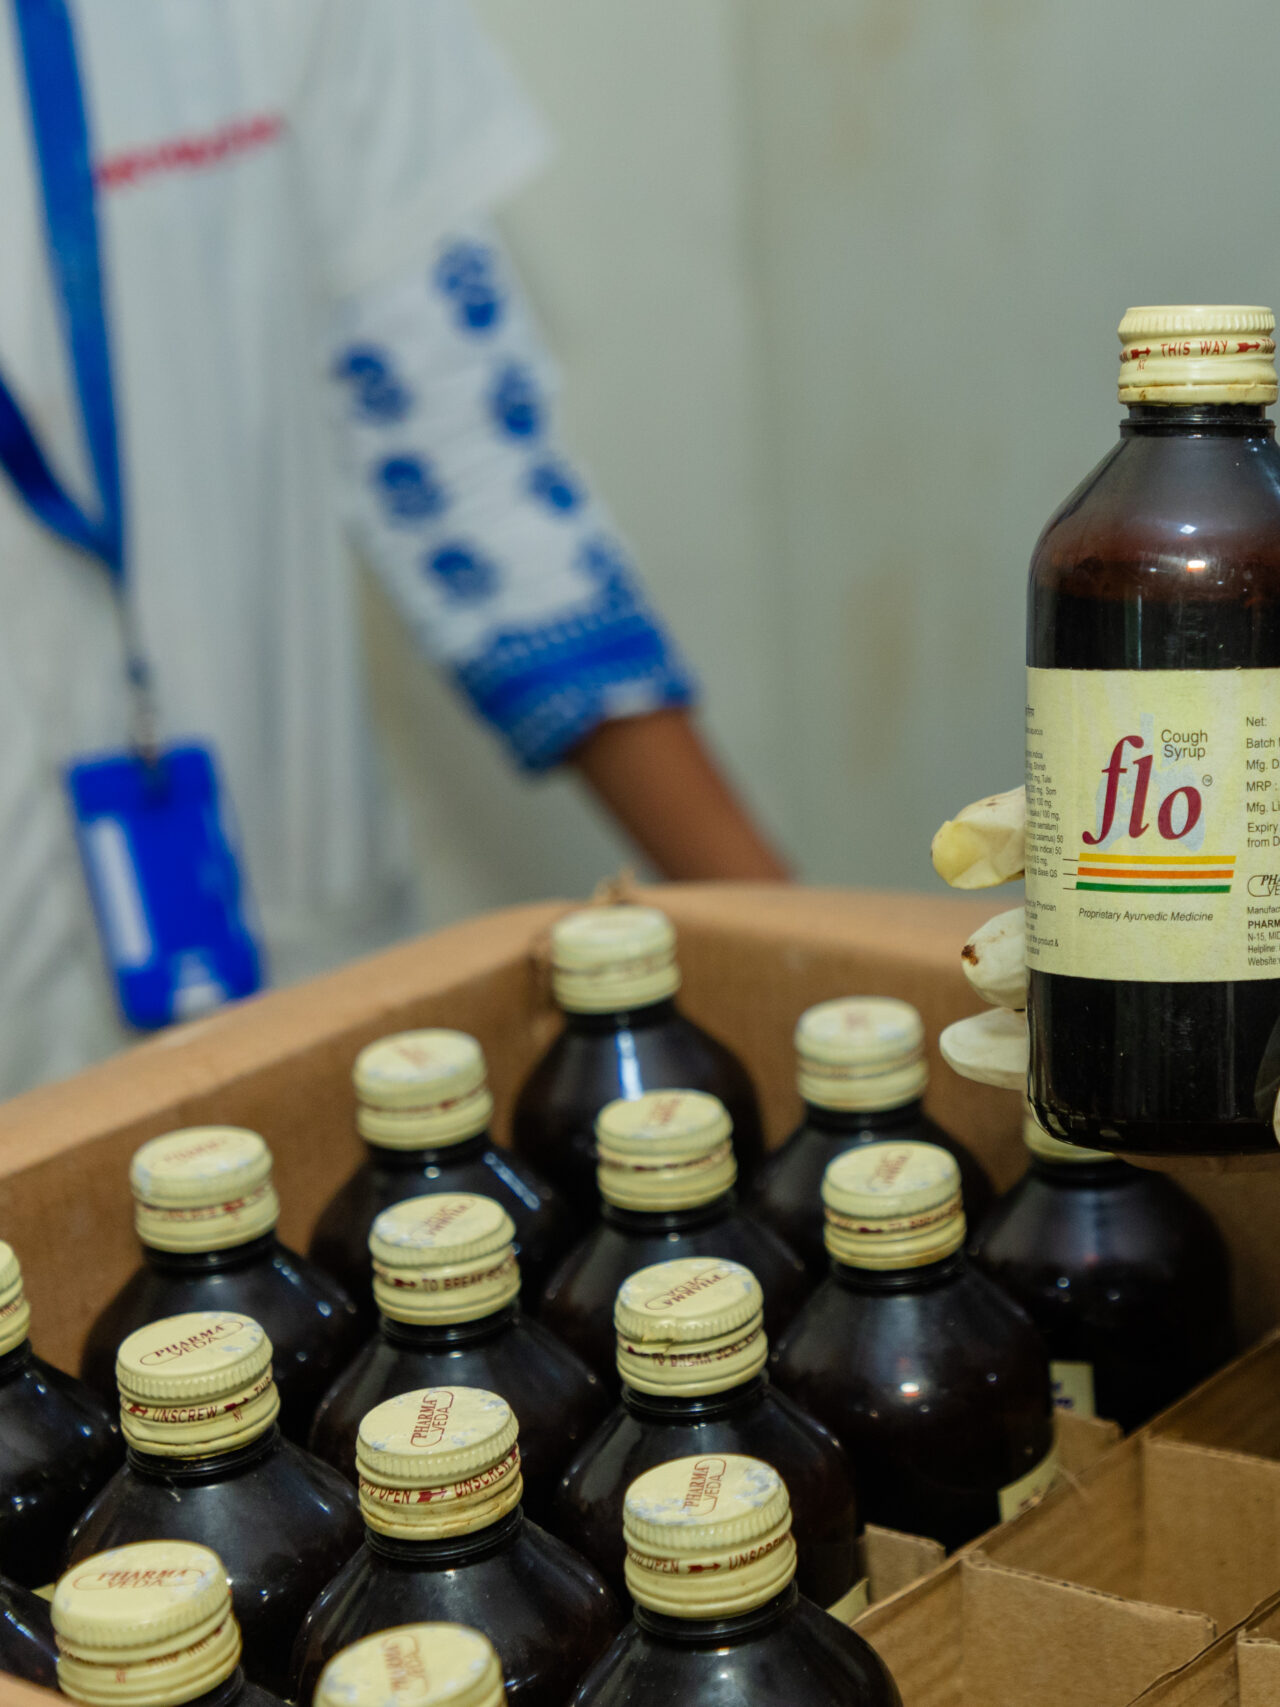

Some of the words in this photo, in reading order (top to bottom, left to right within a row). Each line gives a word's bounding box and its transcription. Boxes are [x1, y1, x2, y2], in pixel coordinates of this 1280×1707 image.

[1160, 342, 1191, 358] THIS
[1199, 340, 1228, 356] WAY
[1246, 716, 1267, 727] Net:
[1161, 729, 1208, 746] Cough
[1246, 737, 1276, 749] Batch
[1163, 744, 1206, 761] Syrup
[1246, 758, 1269, 773] Mfg.
[1082, 735, 1203, 845] flo
[1246, 781, 1272, 792] MRP
[1246, 801, 1269, 815] Mfg.
[1247, 822, 1278, 835] Expiry
[1247, 838, 1270, 848] from
[1079, 907, 1122, 922] Proprietary
[1123, 910, 1168, 923] Ayurvedic
[1170, 911, 1214, 922] Medicine
[153, 1325, 225, 1357] PHARMA
[152, 1406, 218, 1423] UNSCREW
[413, 1399, 438, 1439] PHARMA
[430, 1406, 451, 1433] VEDA
[378, 1487, 412, 1505] OPEN
[453, 1461, 512, 1498] UNSCREW
[683, 1463, 710, 1508] PHARMA
[704, 1473, 723, 1501] VEDA
